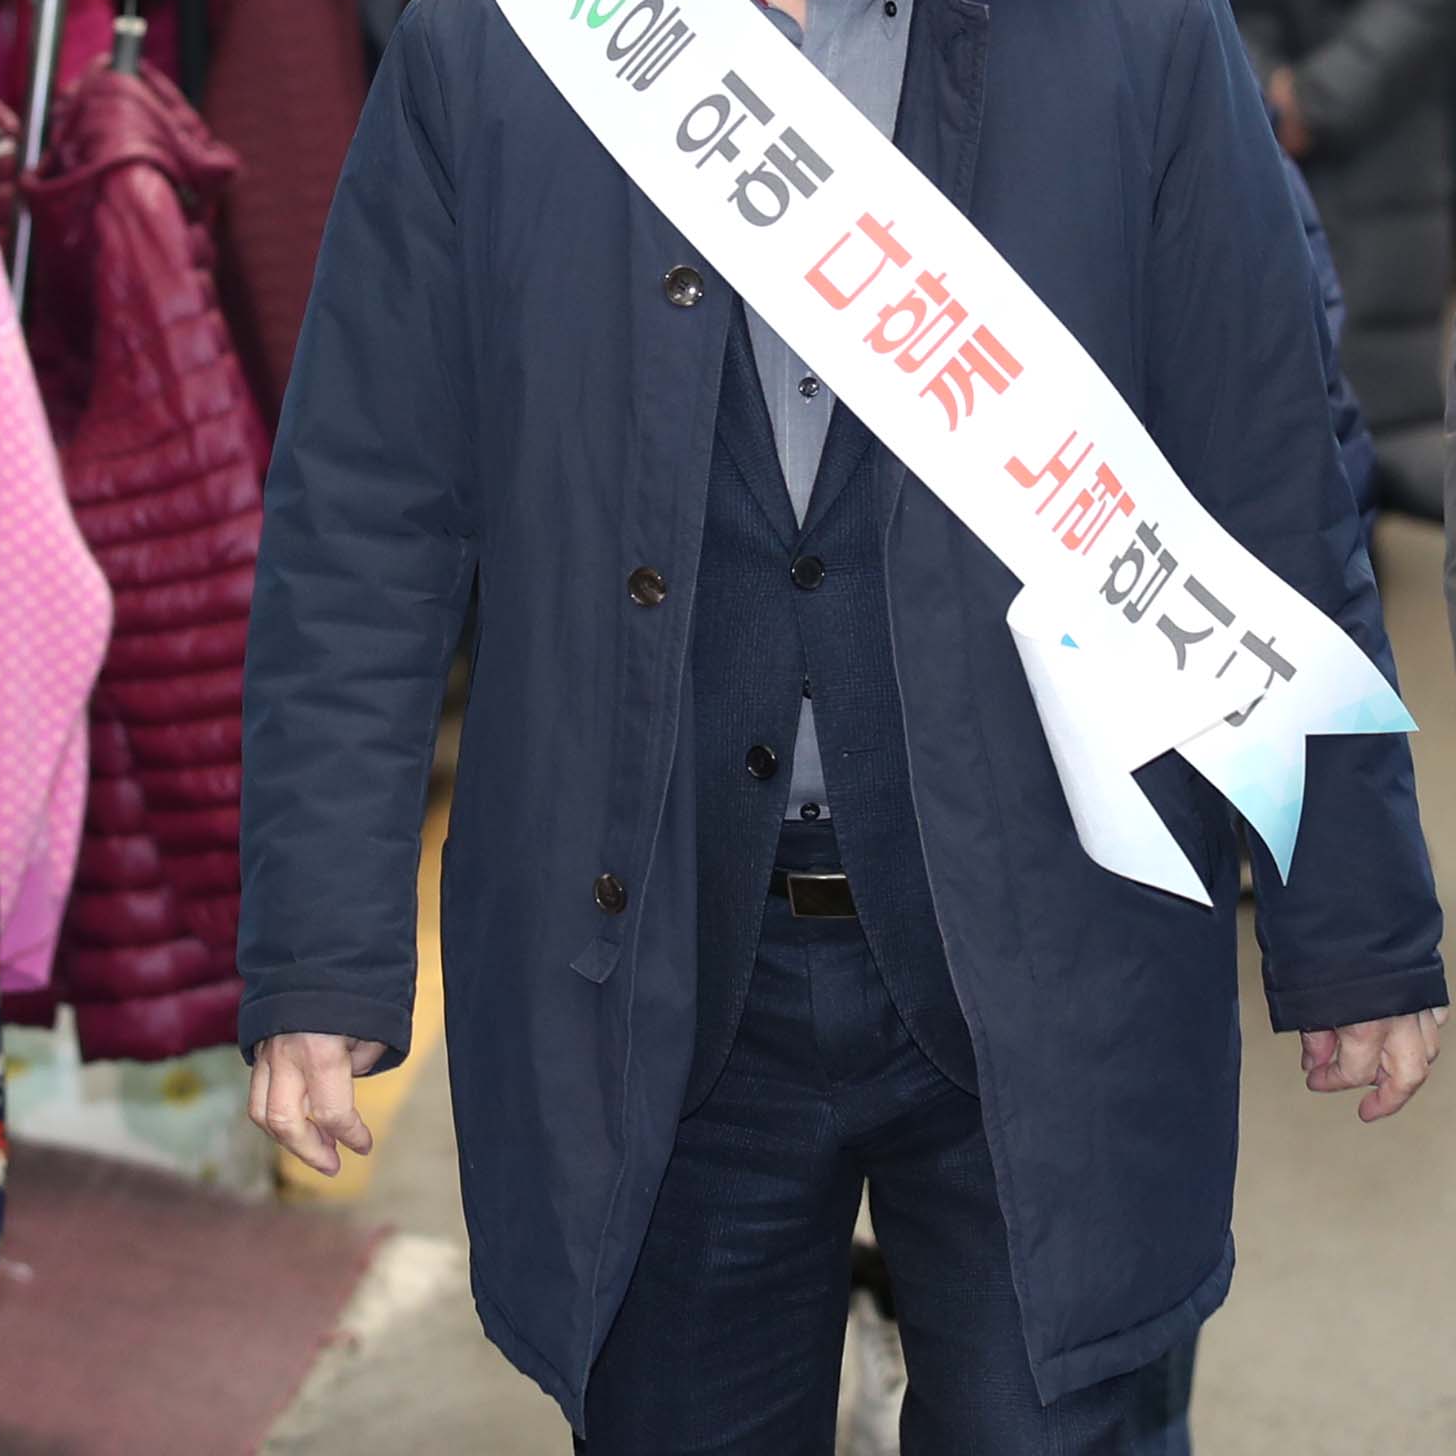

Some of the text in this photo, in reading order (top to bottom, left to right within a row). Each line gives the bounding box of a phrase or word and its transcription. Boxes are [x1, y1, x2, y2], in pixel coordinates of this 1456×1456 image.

[675, 69, 835, 227] 위해
[802, 211, 1025, 432] 다함께
[1003, 430, 1298, 728] 노력합시다
